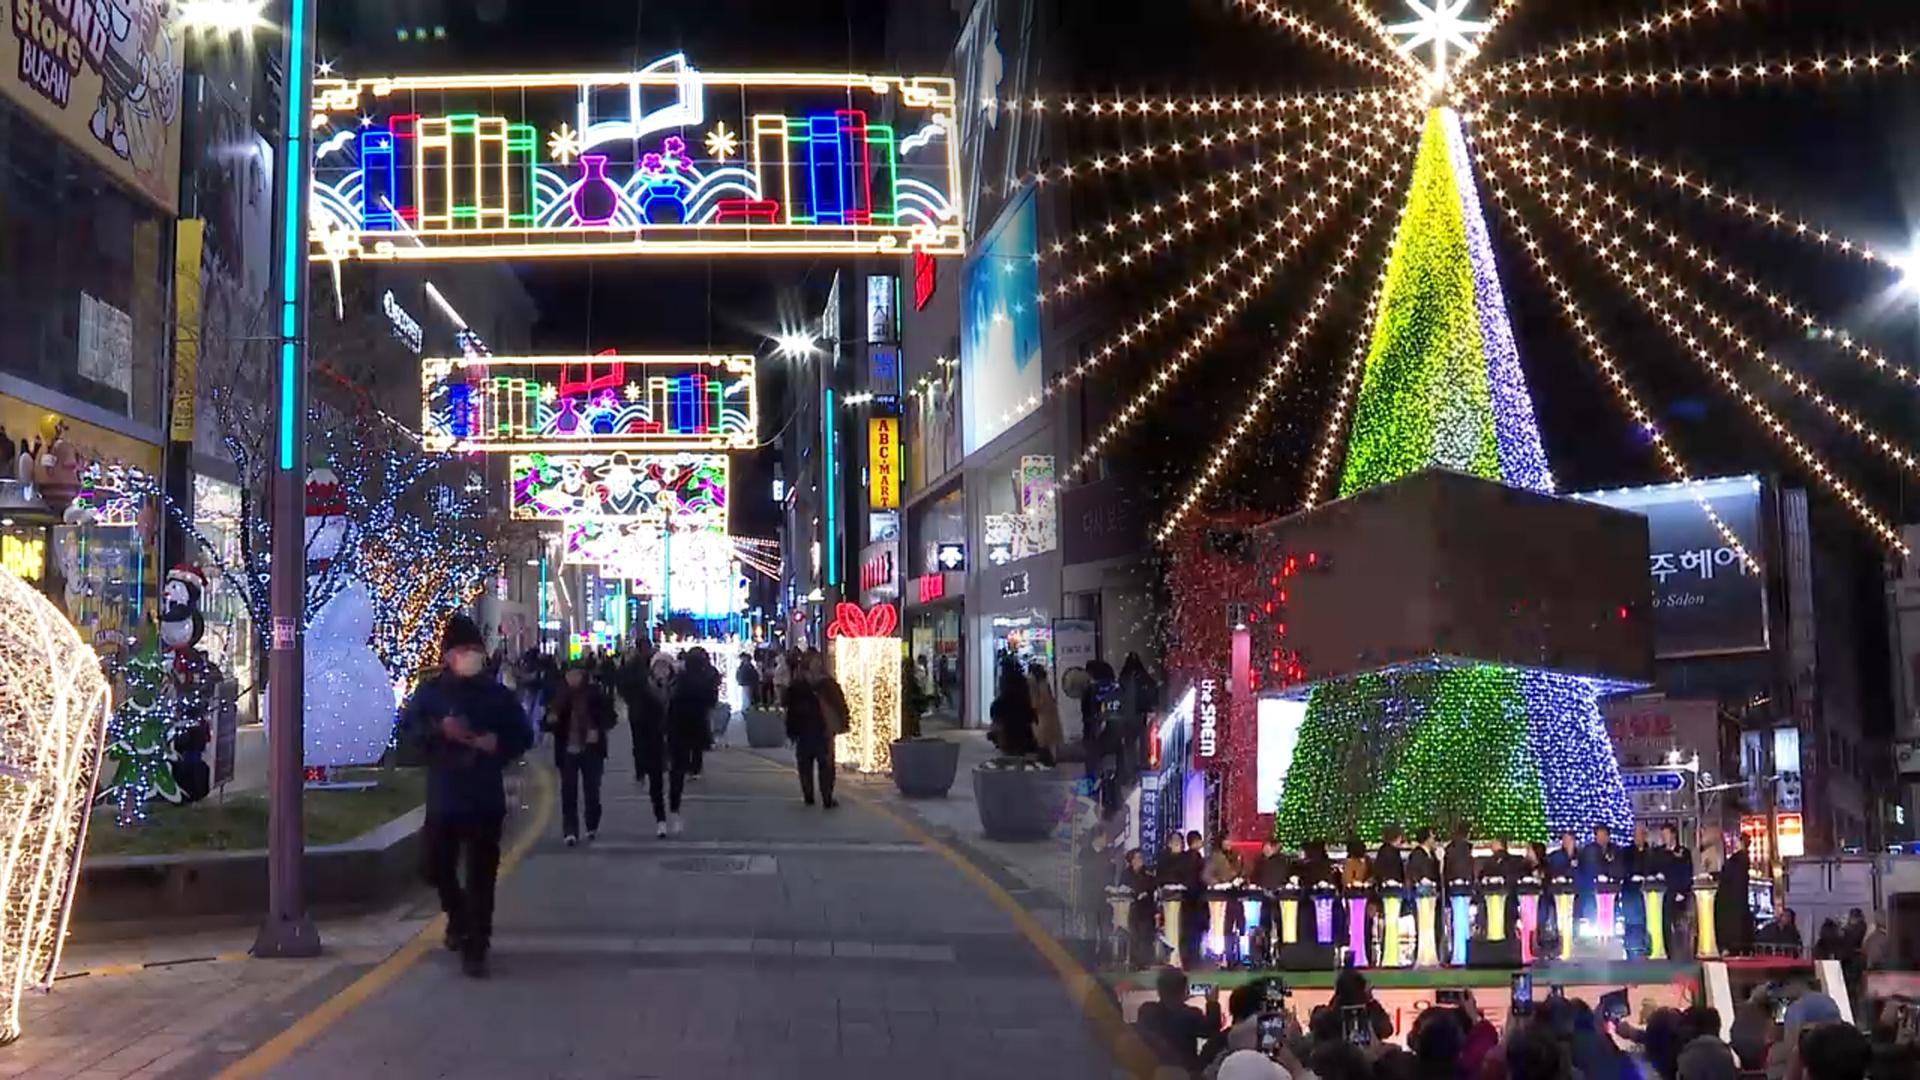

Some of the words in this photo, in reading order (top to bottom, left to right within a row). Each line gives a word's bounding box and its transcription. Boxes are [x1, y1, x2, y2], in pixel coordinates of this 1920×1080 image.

[16, 0, 81, 69] store
[23, 38, 69, 103] BUSAN
[1650, 547, 1746, 583] 주헤어
[1201, 679, 1216, 702] the
